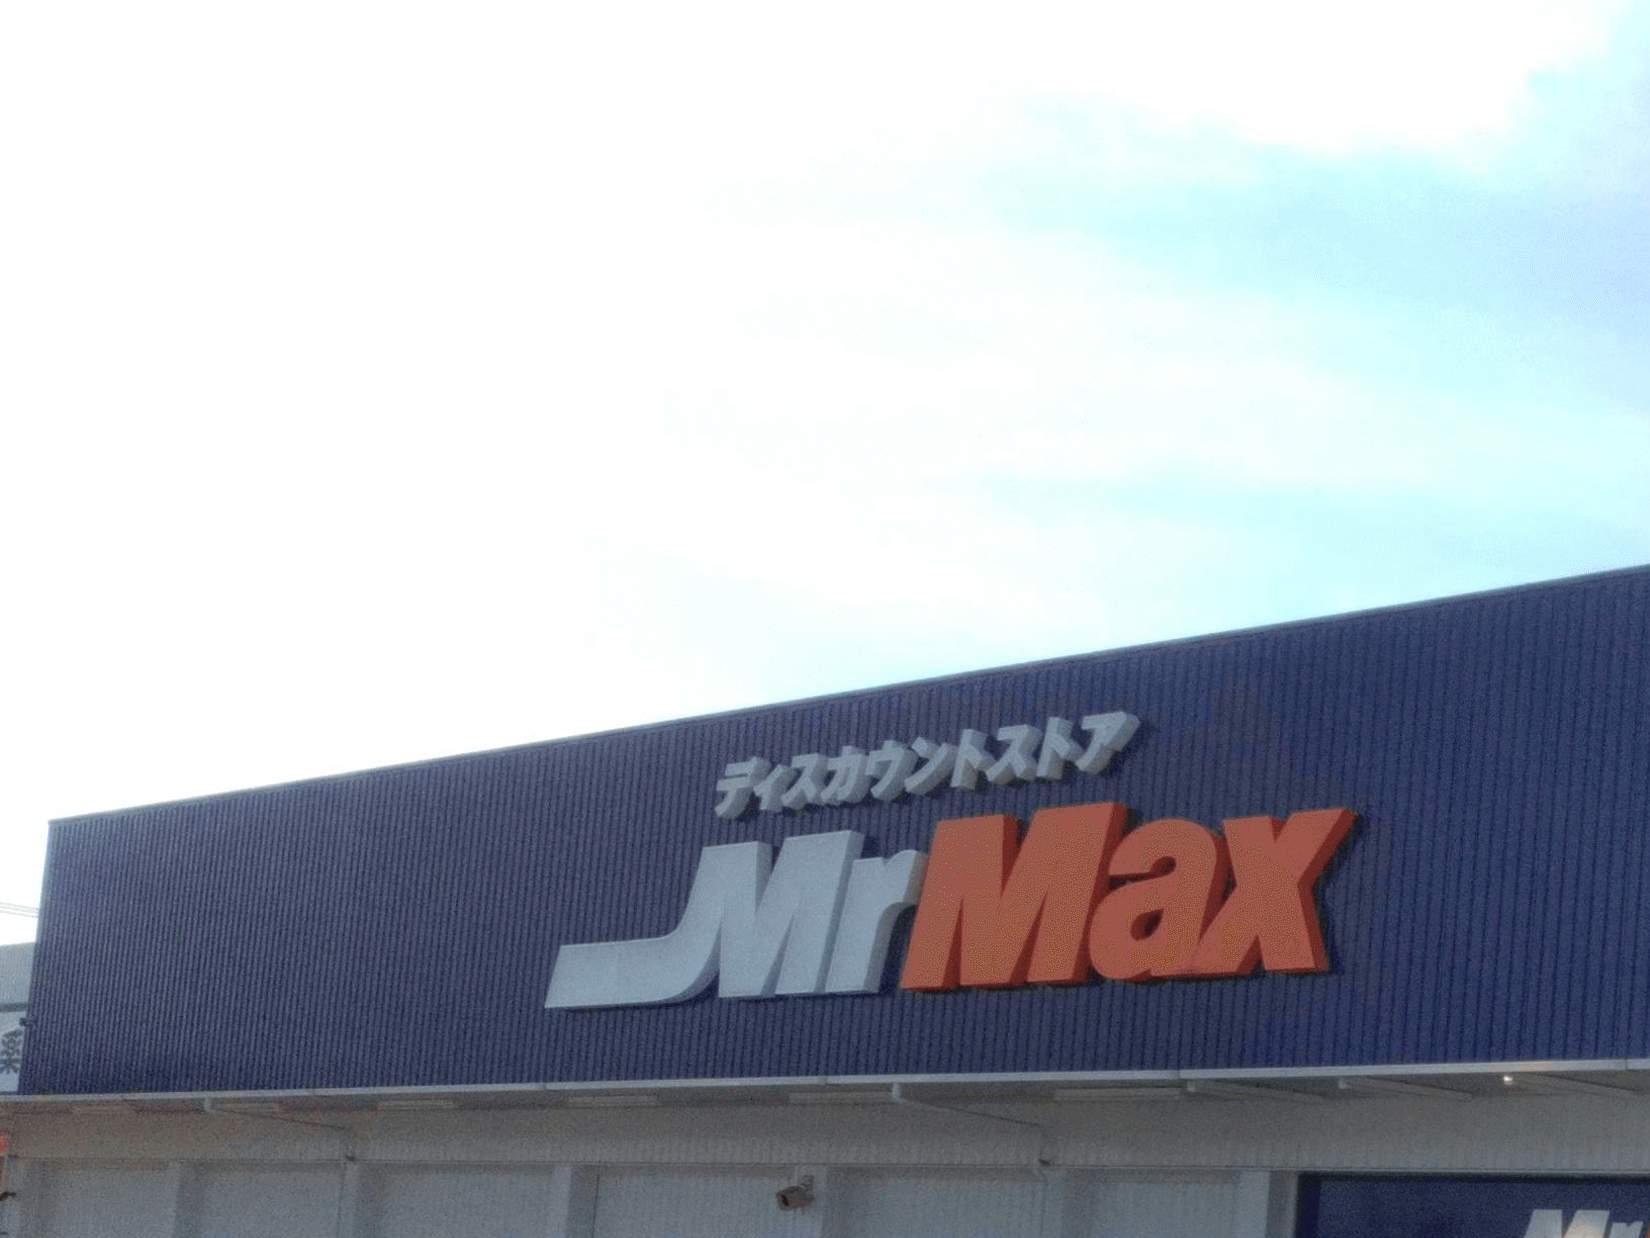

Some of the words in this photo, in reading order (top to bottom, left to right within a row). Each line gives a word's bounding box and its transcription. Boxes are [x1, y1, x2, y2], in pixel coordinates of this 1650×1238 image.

[714, 711, 1141, 819] ディスカウントストア
